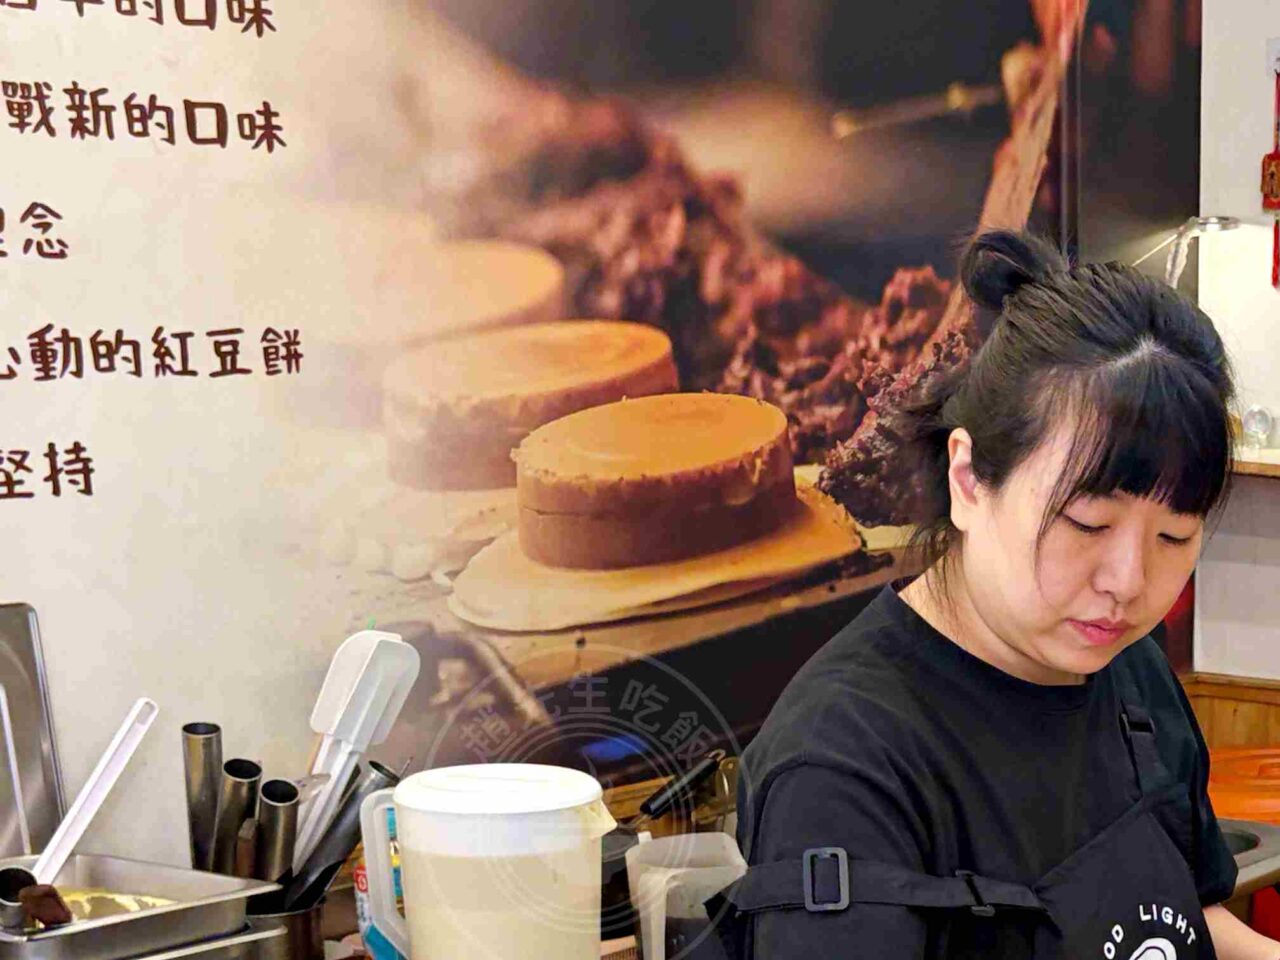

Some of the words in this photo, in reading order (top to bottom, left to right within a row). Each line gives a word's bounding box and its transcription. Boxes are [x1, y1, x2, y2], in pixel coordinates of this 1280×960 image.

[1, 80, 287, 153] 戰新的口味
[0, 201, 69, 260] 念
[1139, 903, 1197, 945] LIGHT
